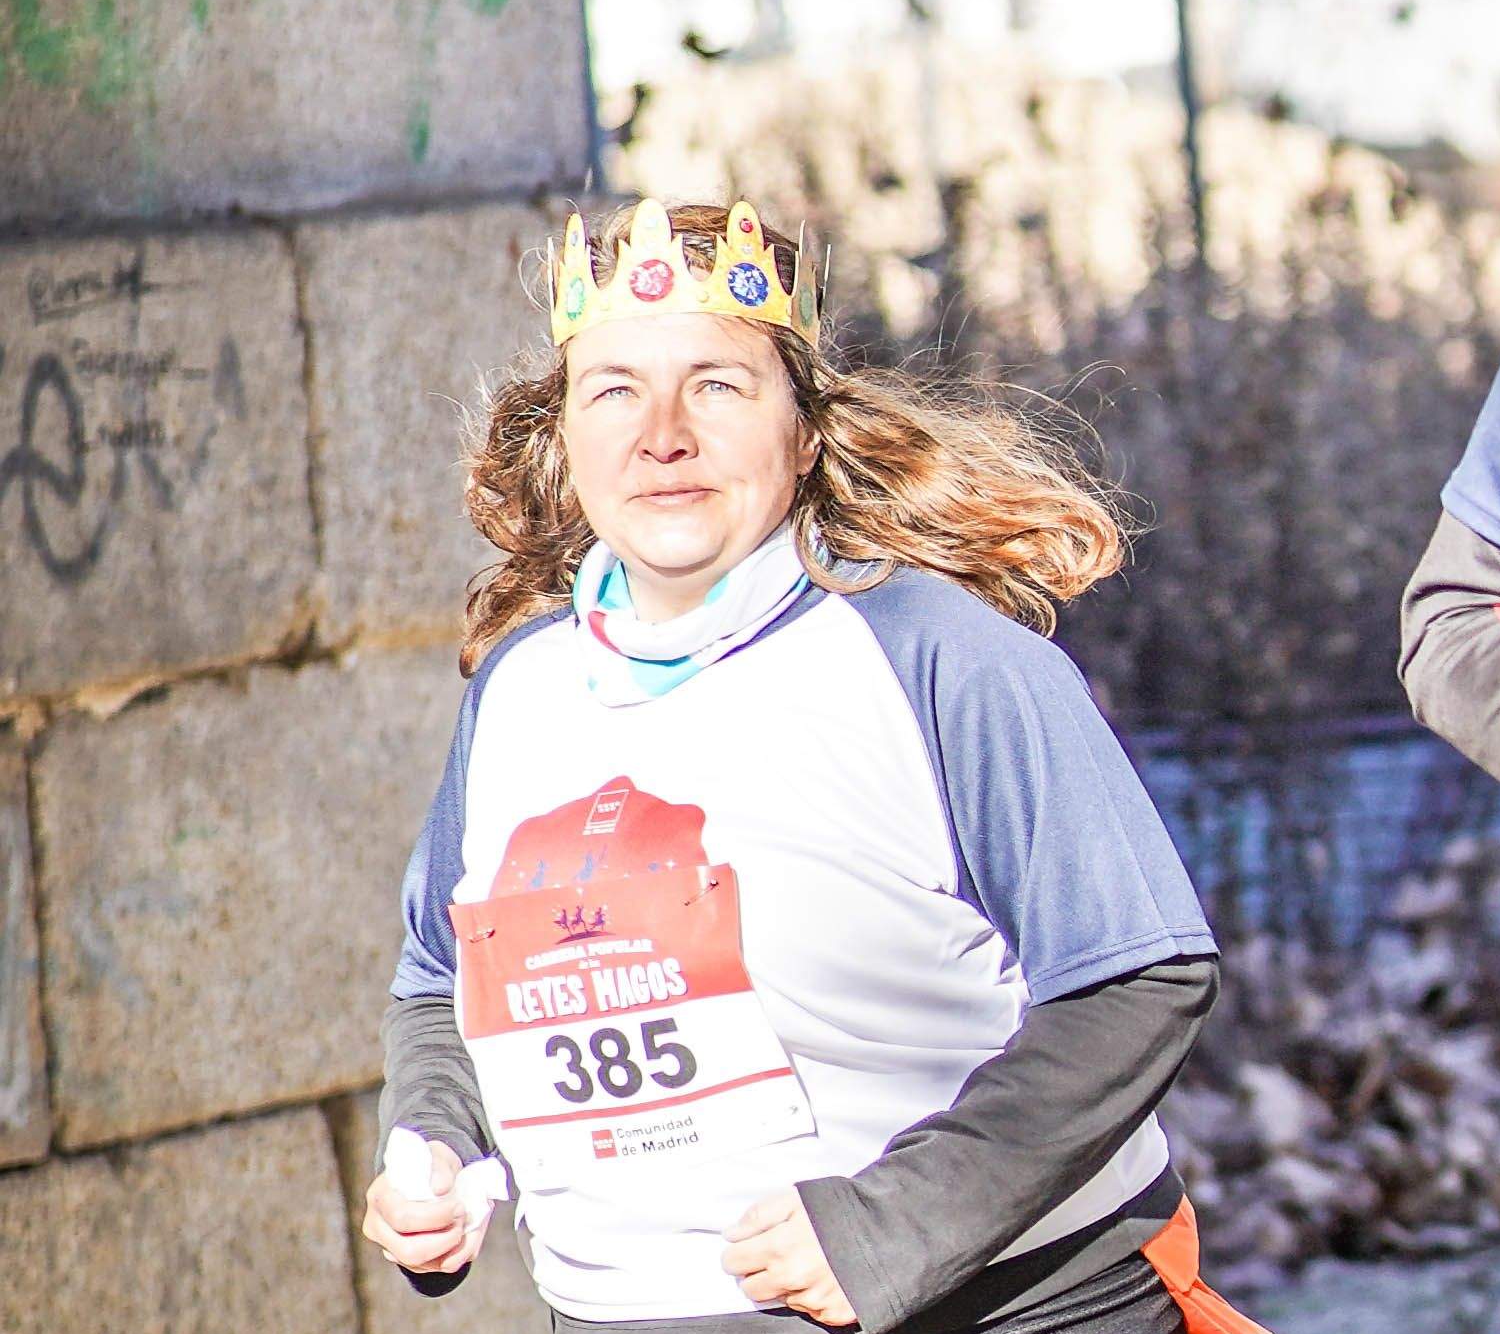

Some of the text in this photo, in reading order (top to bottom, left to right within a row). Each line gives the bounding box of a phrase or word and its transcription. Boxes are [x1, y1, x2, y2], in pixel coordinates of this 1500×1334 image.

[505, 957, 687, 1024] REYES MAGOS
[545, 1017, 698, 1104] 385
[616, 1115, 694, 1139] Comunidad
[621, 1131, 699, 1156] de Madrid
